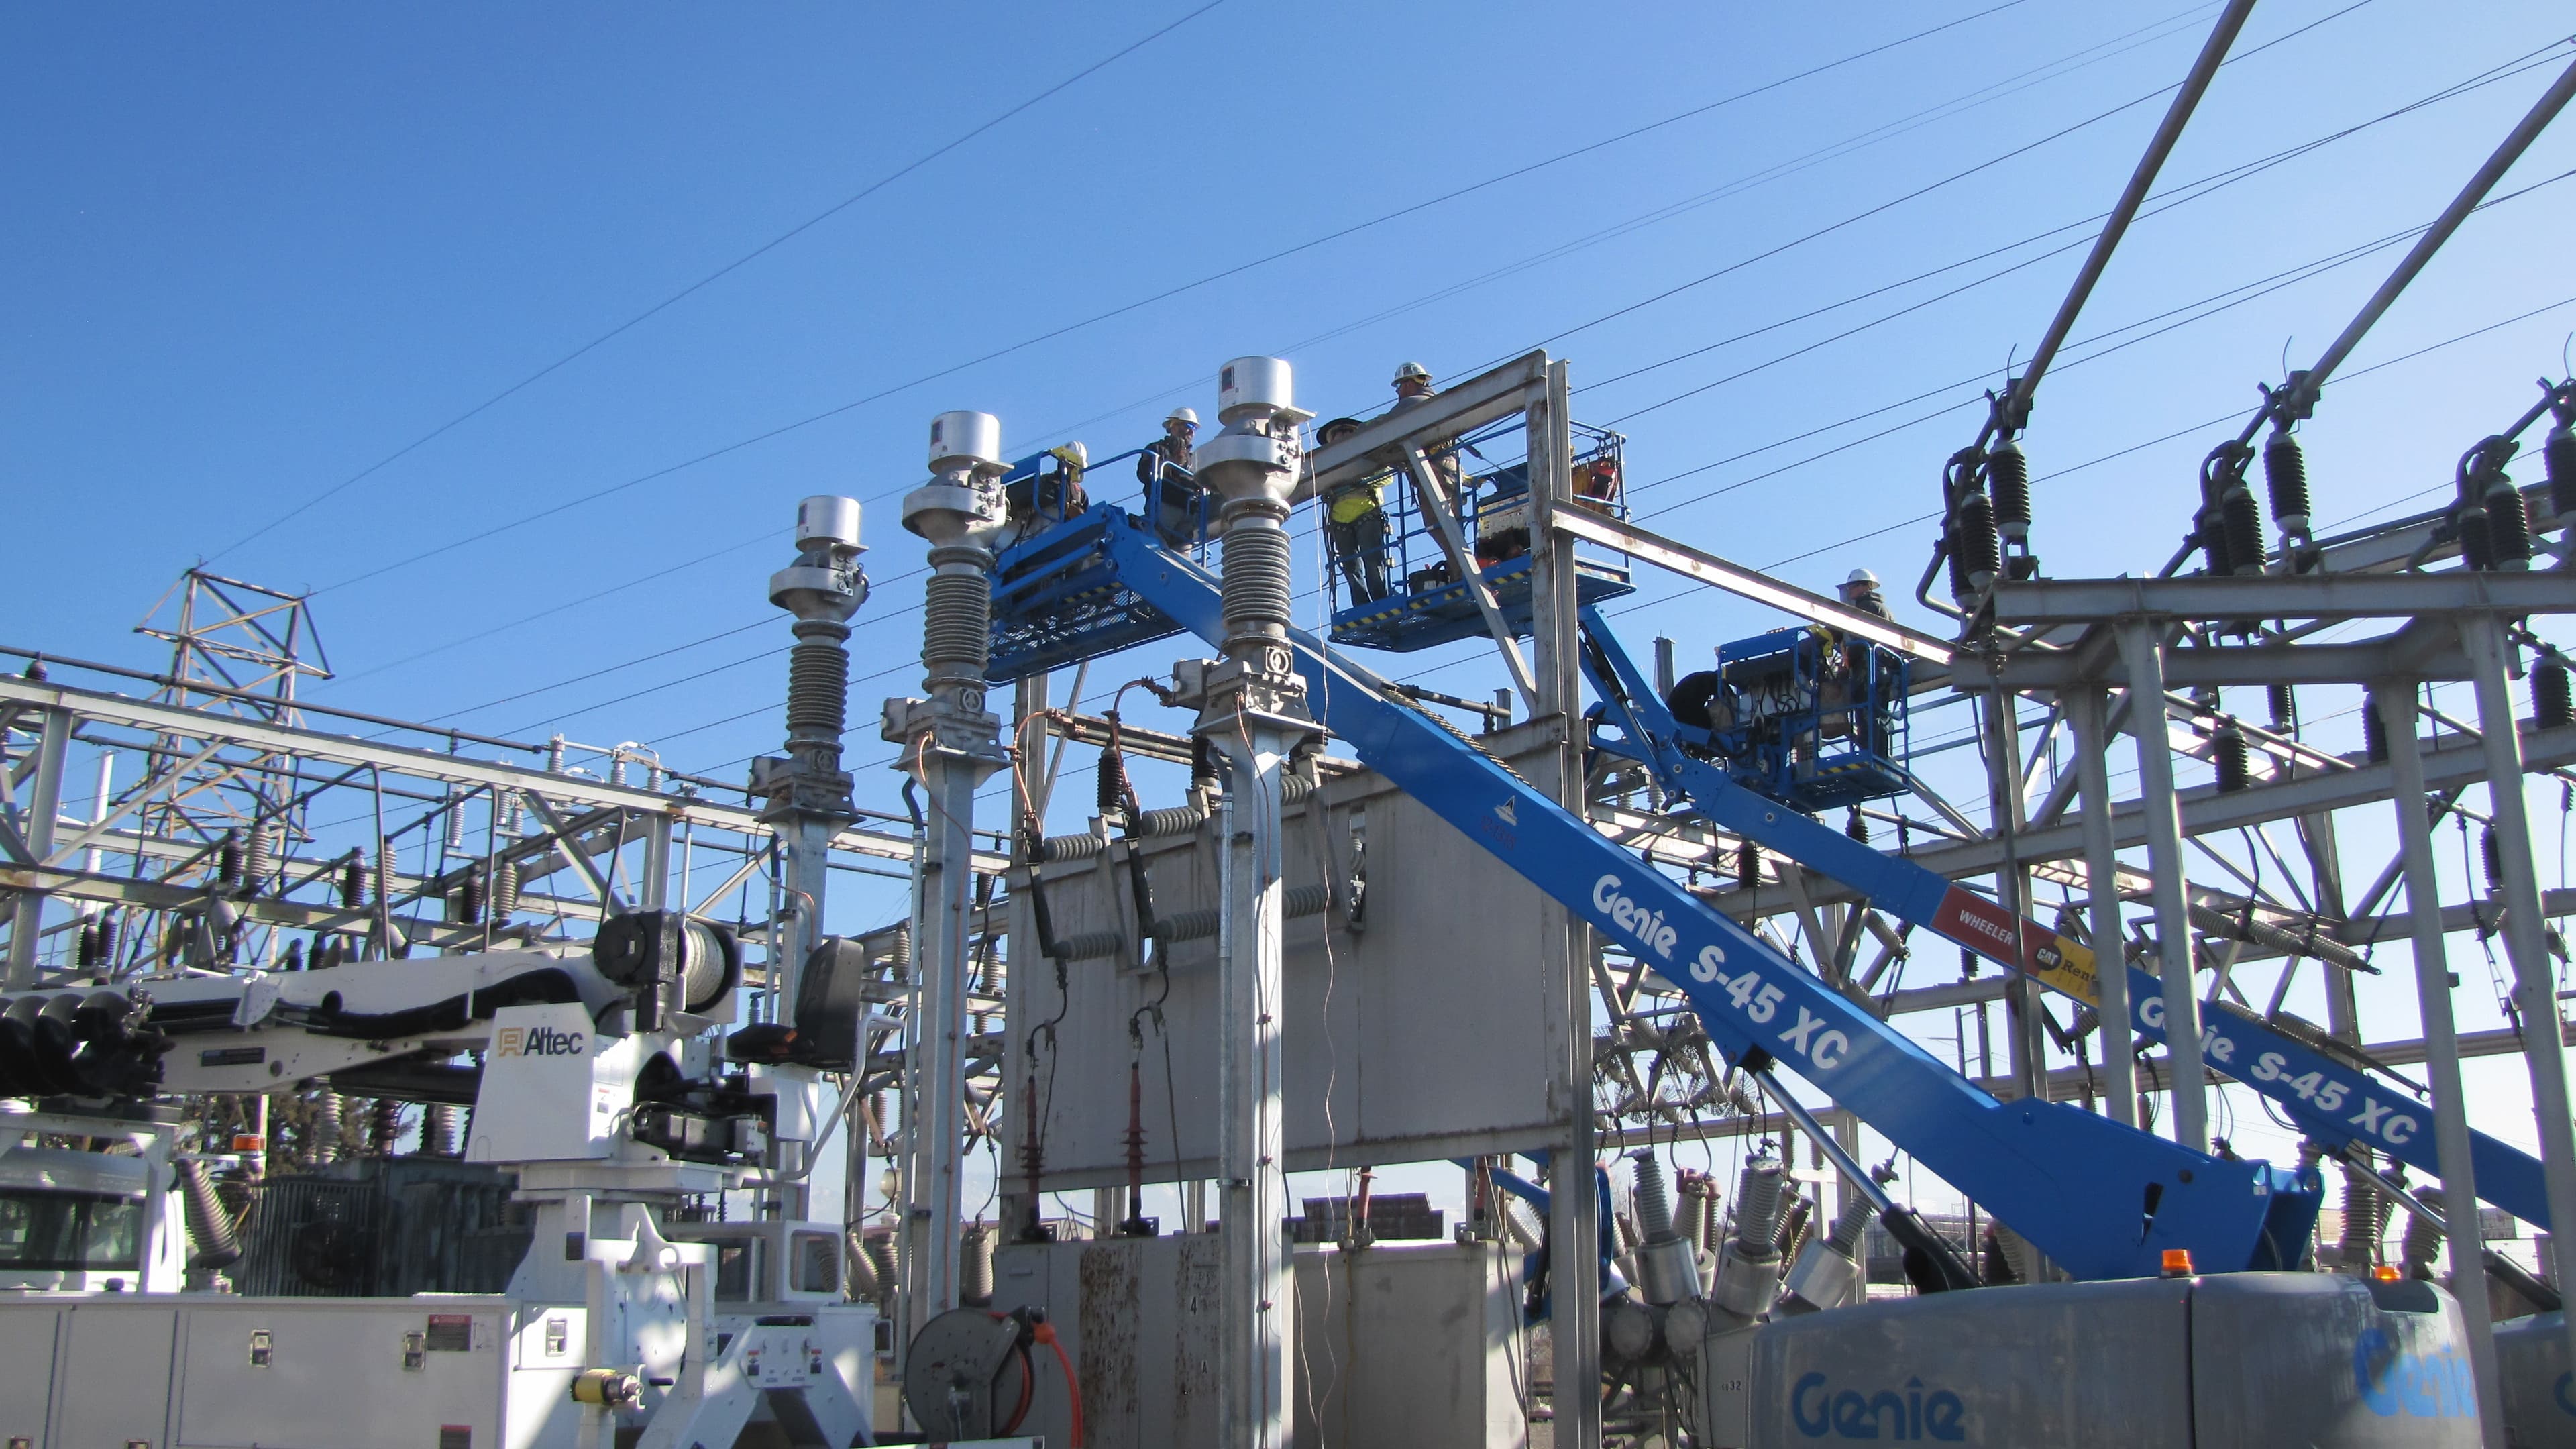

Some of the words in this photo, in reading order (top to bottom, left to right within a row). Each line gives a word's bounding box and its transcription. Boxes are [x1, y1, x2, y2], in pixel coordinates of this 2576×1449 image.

[1958, 909, 2014, 945] WHEELER
[1593, 874, 1677, 959] Genie
[1690, 945, 1785, 1023] S-45
[1778, 1006, 1849, 1069] XC
[2036, 947, 2058, 965] CAT
[523, 1026, 583, 1056] Altec
[2250, 1051, 2350, 1112] S-45
[2347, 1098, 2418, 1145] XC
[1792, 1371, 1964, 1442] Genie
